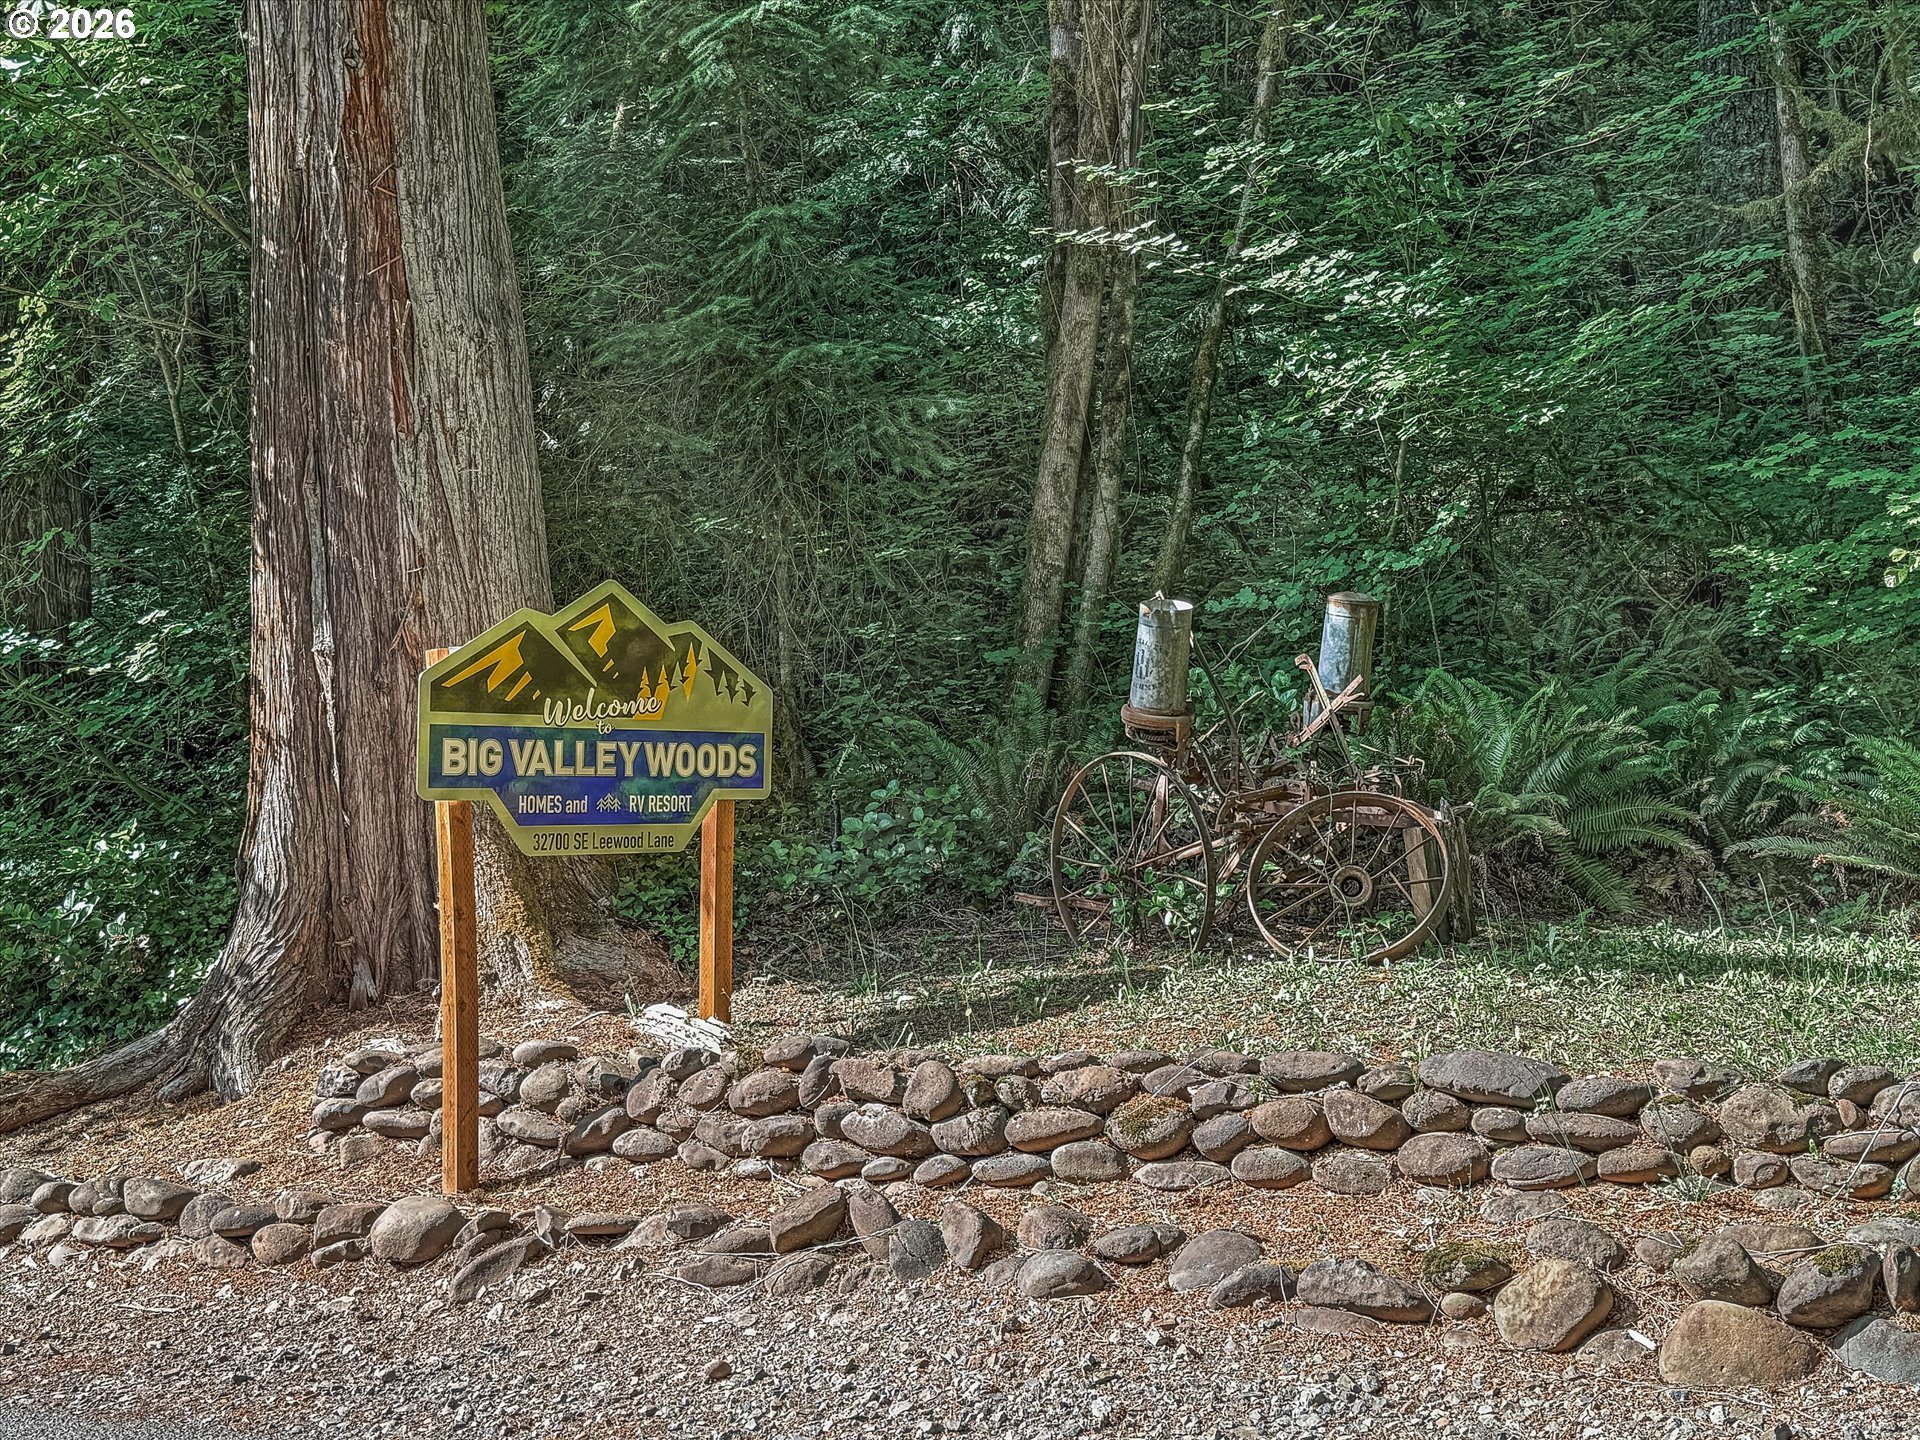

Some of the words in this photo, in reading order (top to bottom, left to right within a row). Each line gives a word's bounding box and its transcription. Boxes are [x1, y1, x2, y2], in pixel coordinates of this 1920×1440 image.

[542, 687, 662, 726] Welcome
[597, 720, 614, 734] to
[441, 738, 502, 776] BIG
[508, 739, 643, 777] VALLEY
[645, 742, 758, 778] WOODS
[518, 795, 562, 814] HOMES
[566, 795, 588, 813] and
[629, 795, 645, 813] RV
[648, 795, 692, 812] RESORT
[533, 834, 571, 851] 32700
[573, 833, 589, 850] SE
[592, 833, 643, 849] Leewood
[646, 832, 674, 848] Lane
